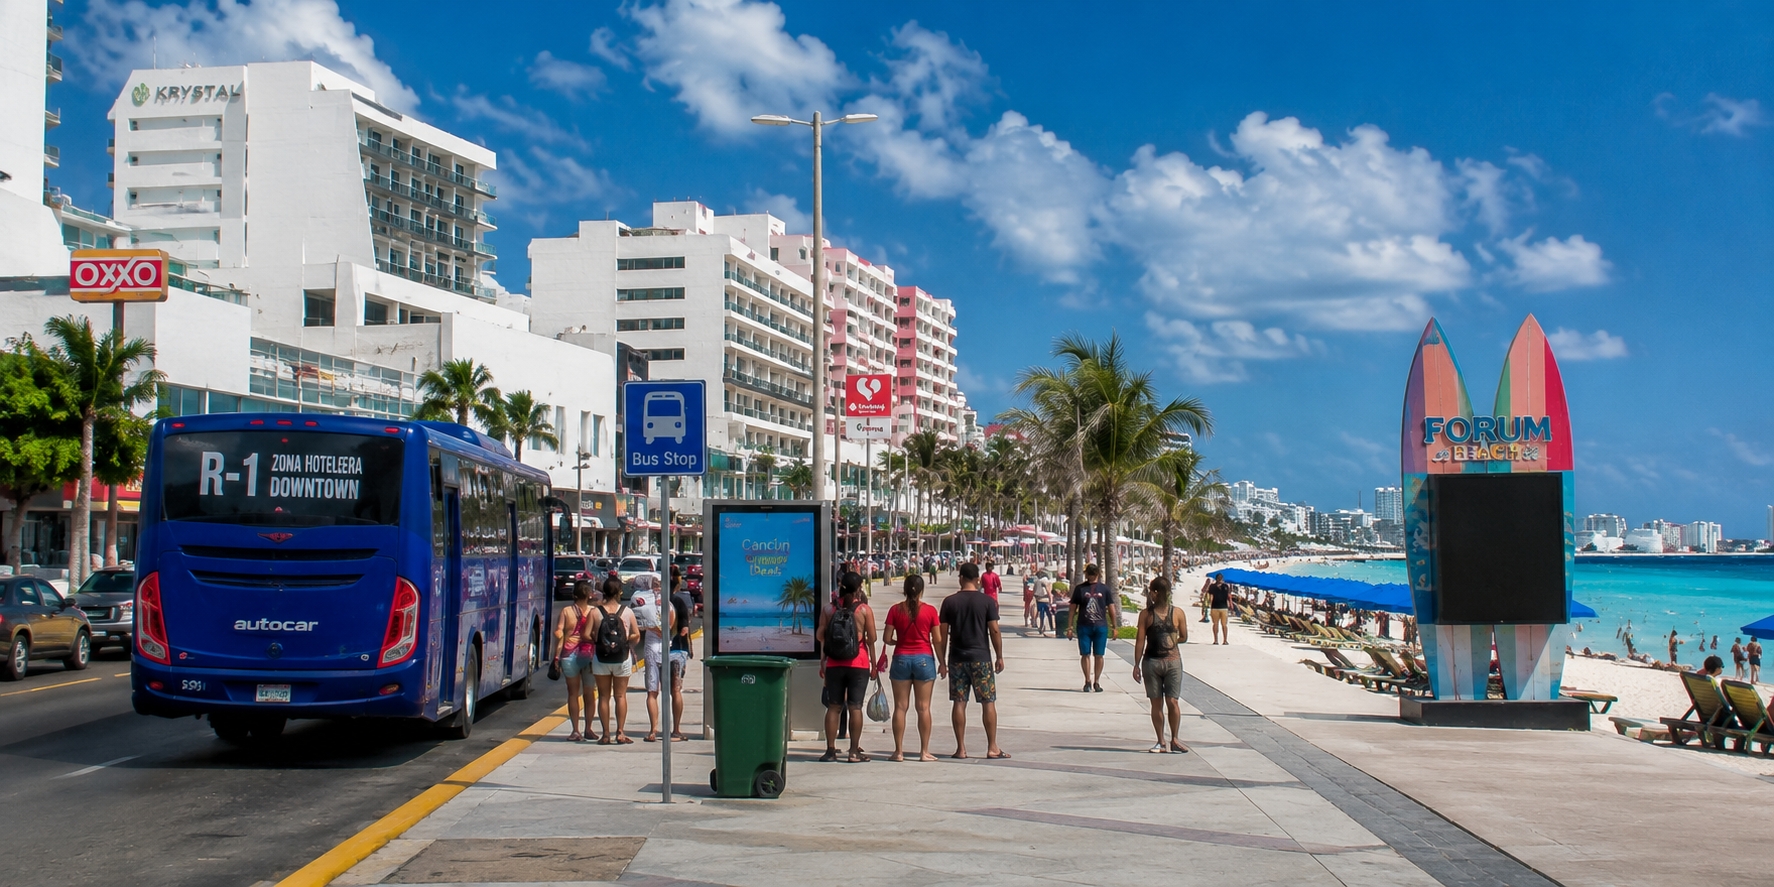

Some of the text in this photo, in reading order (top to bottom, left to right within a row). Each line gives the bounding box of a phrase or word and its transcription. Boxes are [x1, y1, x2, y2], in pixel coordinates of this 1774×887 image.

[155, 85, 241, 100] KRYSTAL
[75, 262, 157, 287] OXXO
[1424, 416, 1552, 443] FORUM
[632, 451, 697, 469] Bus Stop
[1453, 443, 1521, 460] BEACH
[271, 454, 301, 472] ZONA
[199, 451, 259, 496] R-1
[269, 477, 359, 499] DOWNTOWN
[233, 618, 318, 632] autocar
